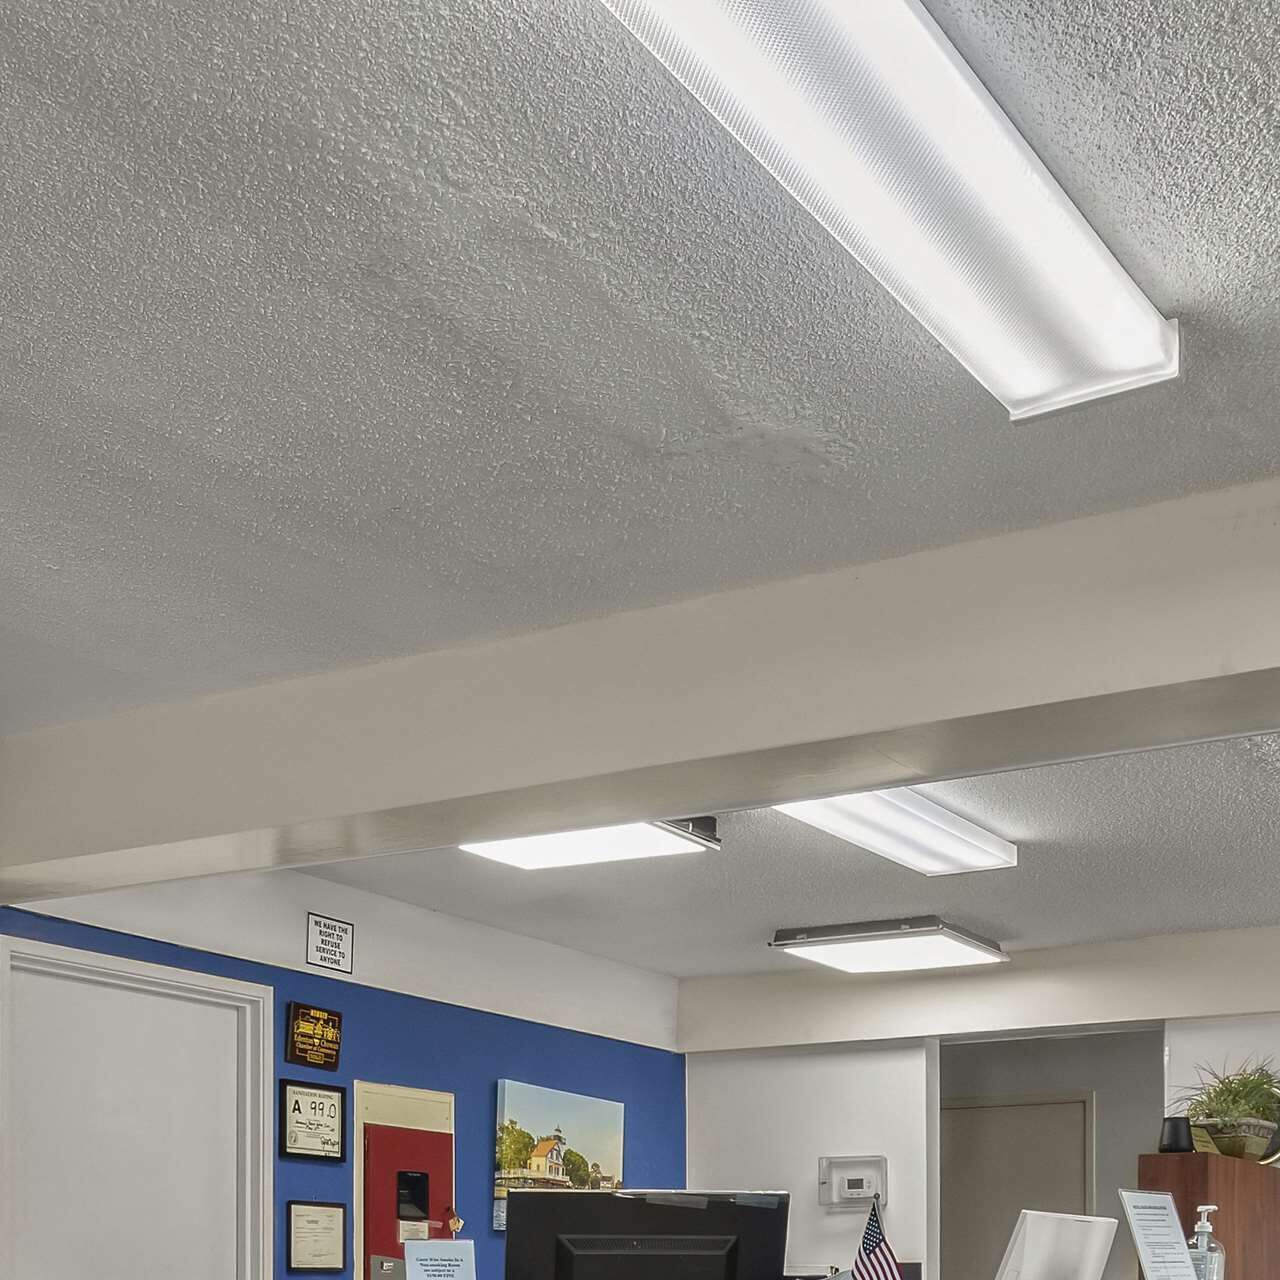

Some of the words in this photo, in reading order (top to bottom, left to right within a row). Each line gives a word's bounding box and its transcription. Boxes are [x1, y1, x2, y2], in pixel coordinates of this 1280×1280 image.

[314, 920, 322, 928] WE
[323, 922, 337, 932] HAVE
[338, 926, 348, 935] THE
[319, 929, 335, 939] RIGHT
[336, 933, 343, 942] TO
[321, 938, 340, 950] REFUSE
[315, 945, 337, 957] SERVICE
[338, 951, 345, 959] TO
[320, 955, 341, 966] ANYONE
[292, 1099, 302, 1114] A
